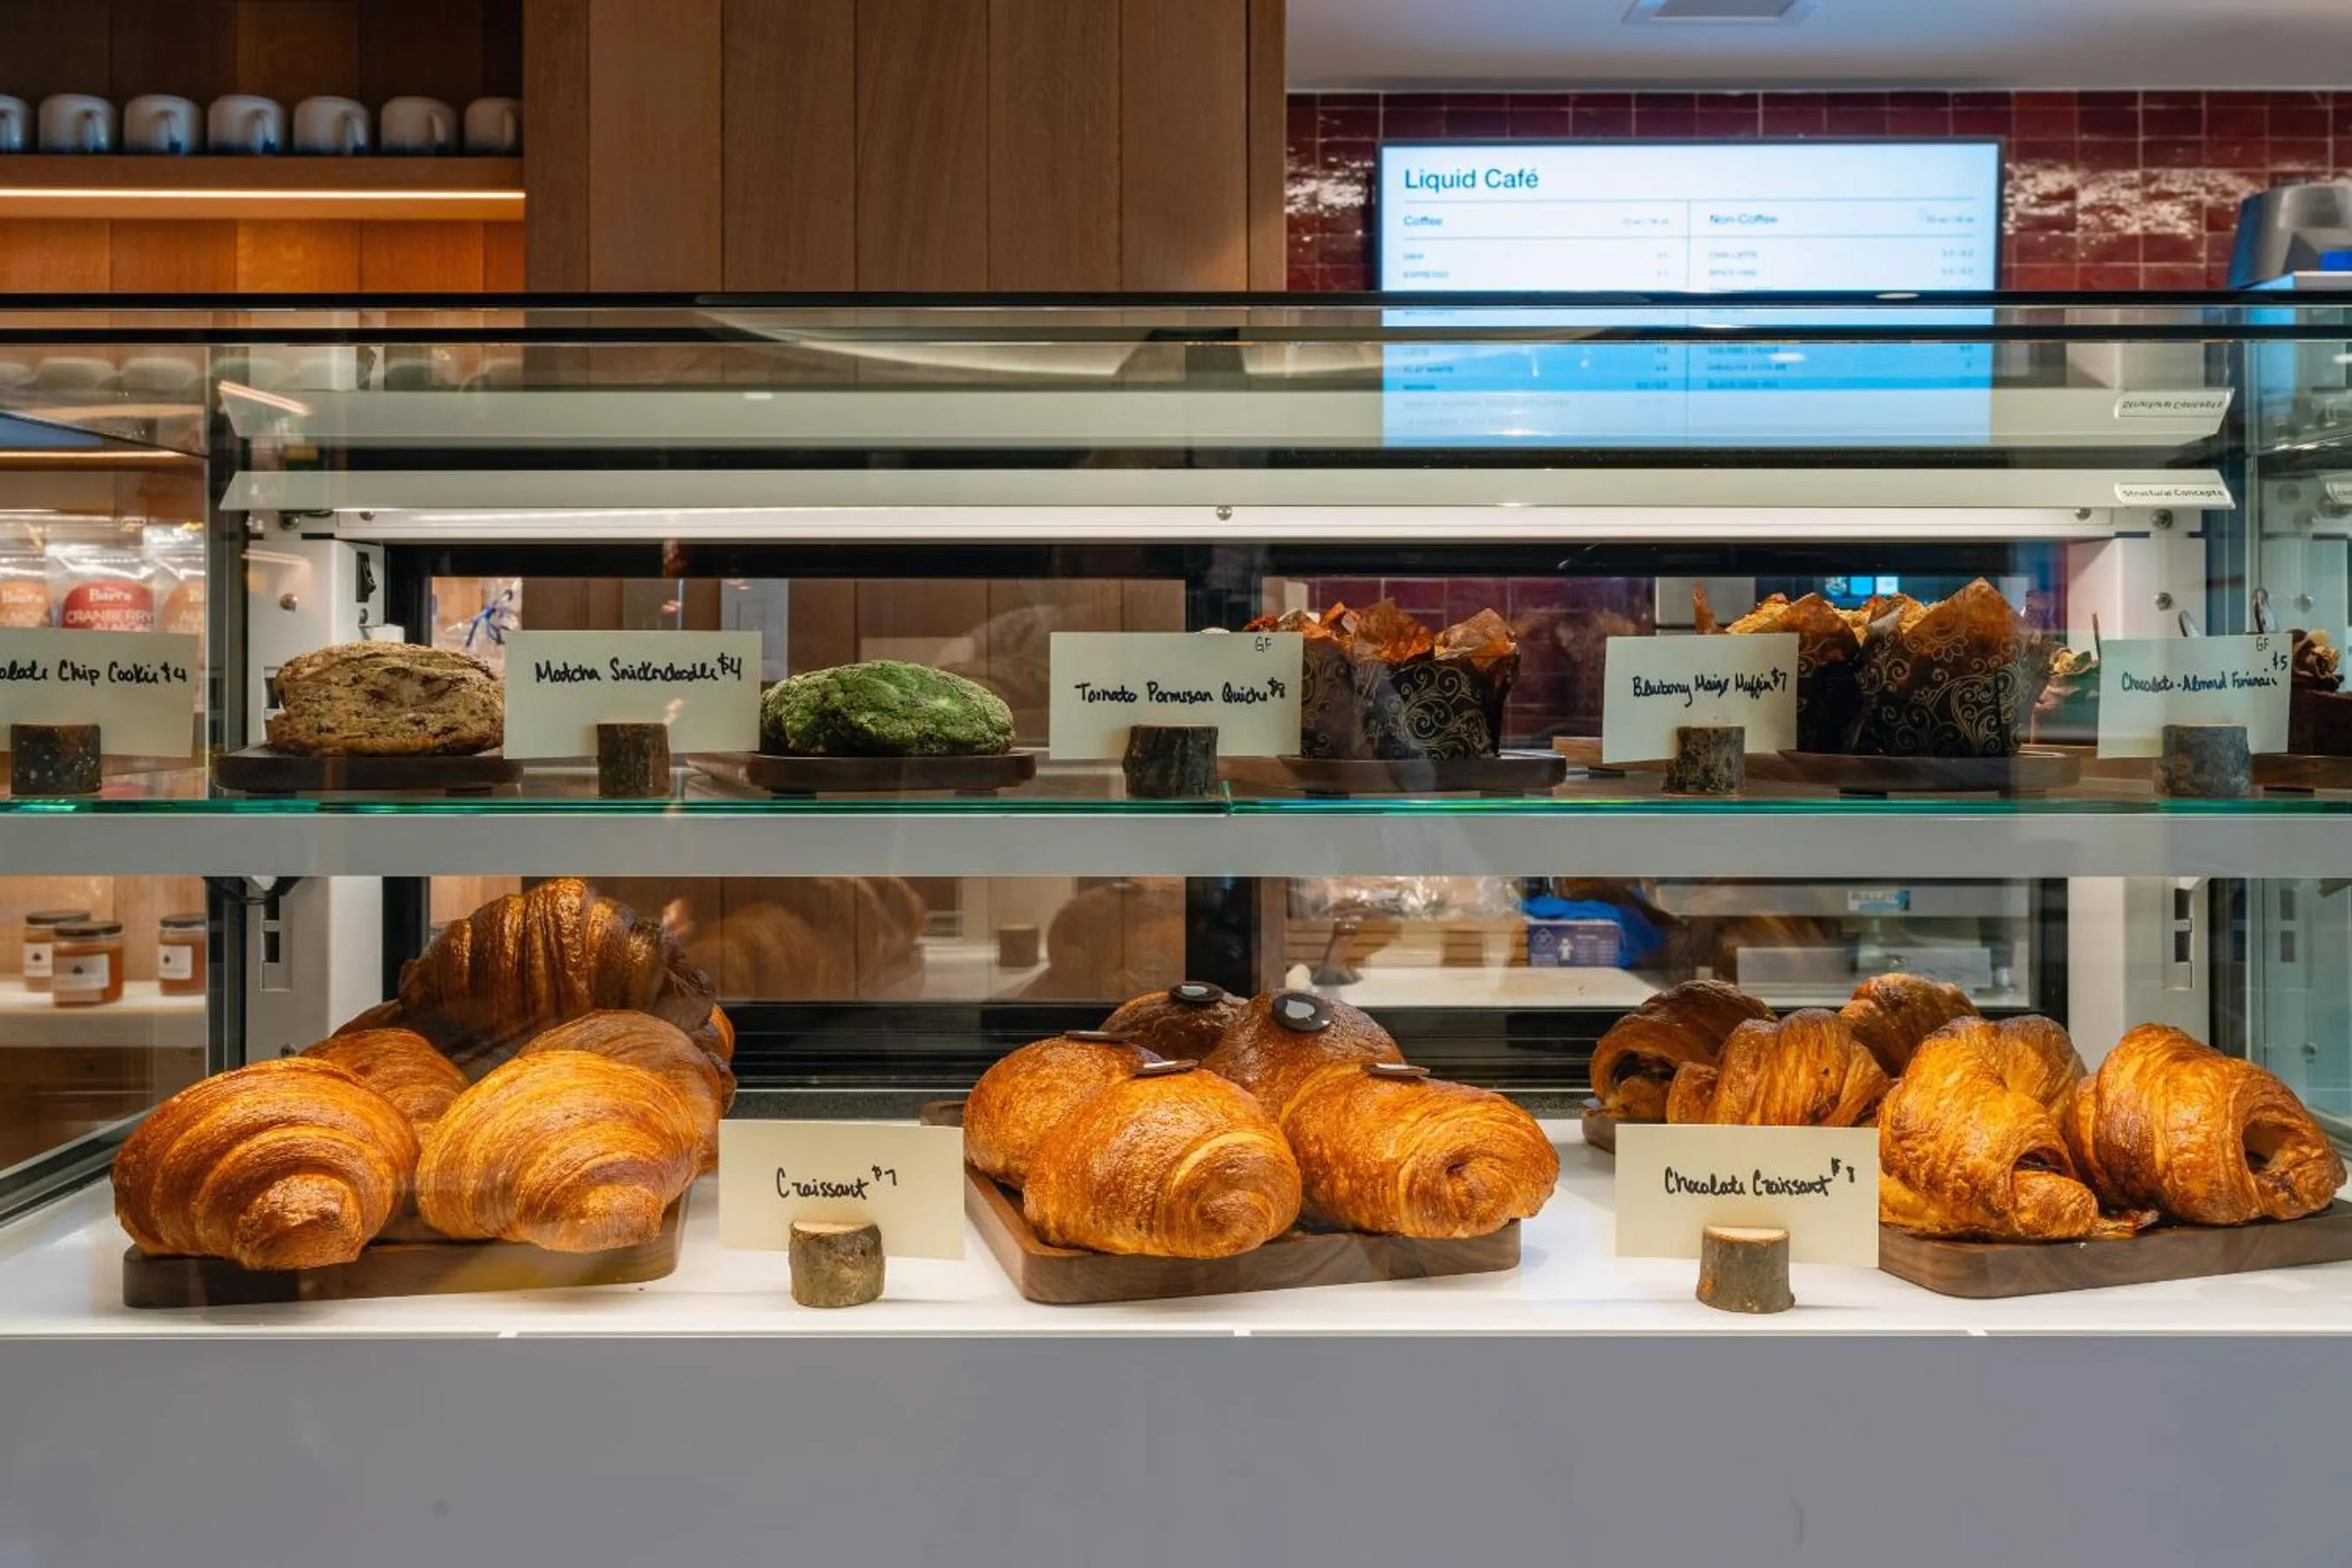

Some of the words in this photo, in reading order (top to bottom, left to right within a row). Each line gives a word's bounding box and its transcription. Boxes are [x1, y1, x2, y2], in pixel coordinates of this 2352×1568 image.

[1404, 168, 1477, 193] Liquid
[1484, 168, 1539, 189] Café
[1403, 215, 1443, 226] Coffee
[1709, 213, 1779, 225] Non-Coffee
[1254, 636, 1273, 652] GF
[2255, 636, 2269, 652] GF
[57, 659, 100, 686] Chip
[160, 662, 187, 682] $4
[535, 659, 601, 683] Matcha
[717, 652, 743, 681] $4
[2272, 652, 2288, 672] $5
[1074, 682, 1138, 703] Tomato
[1146, 681, 1214, 704] Parmesan
[1735, 672, 1774, 700] Muffin
[1771, 667, 1788, 693] $7
[776, 1166, 869, 1200] Croissant
[872, 1164, 897, 1186] $7
[1664, 1166, 1747, 1195] Chocolate
[1752, 1168, 1833, 1197] Croissant
